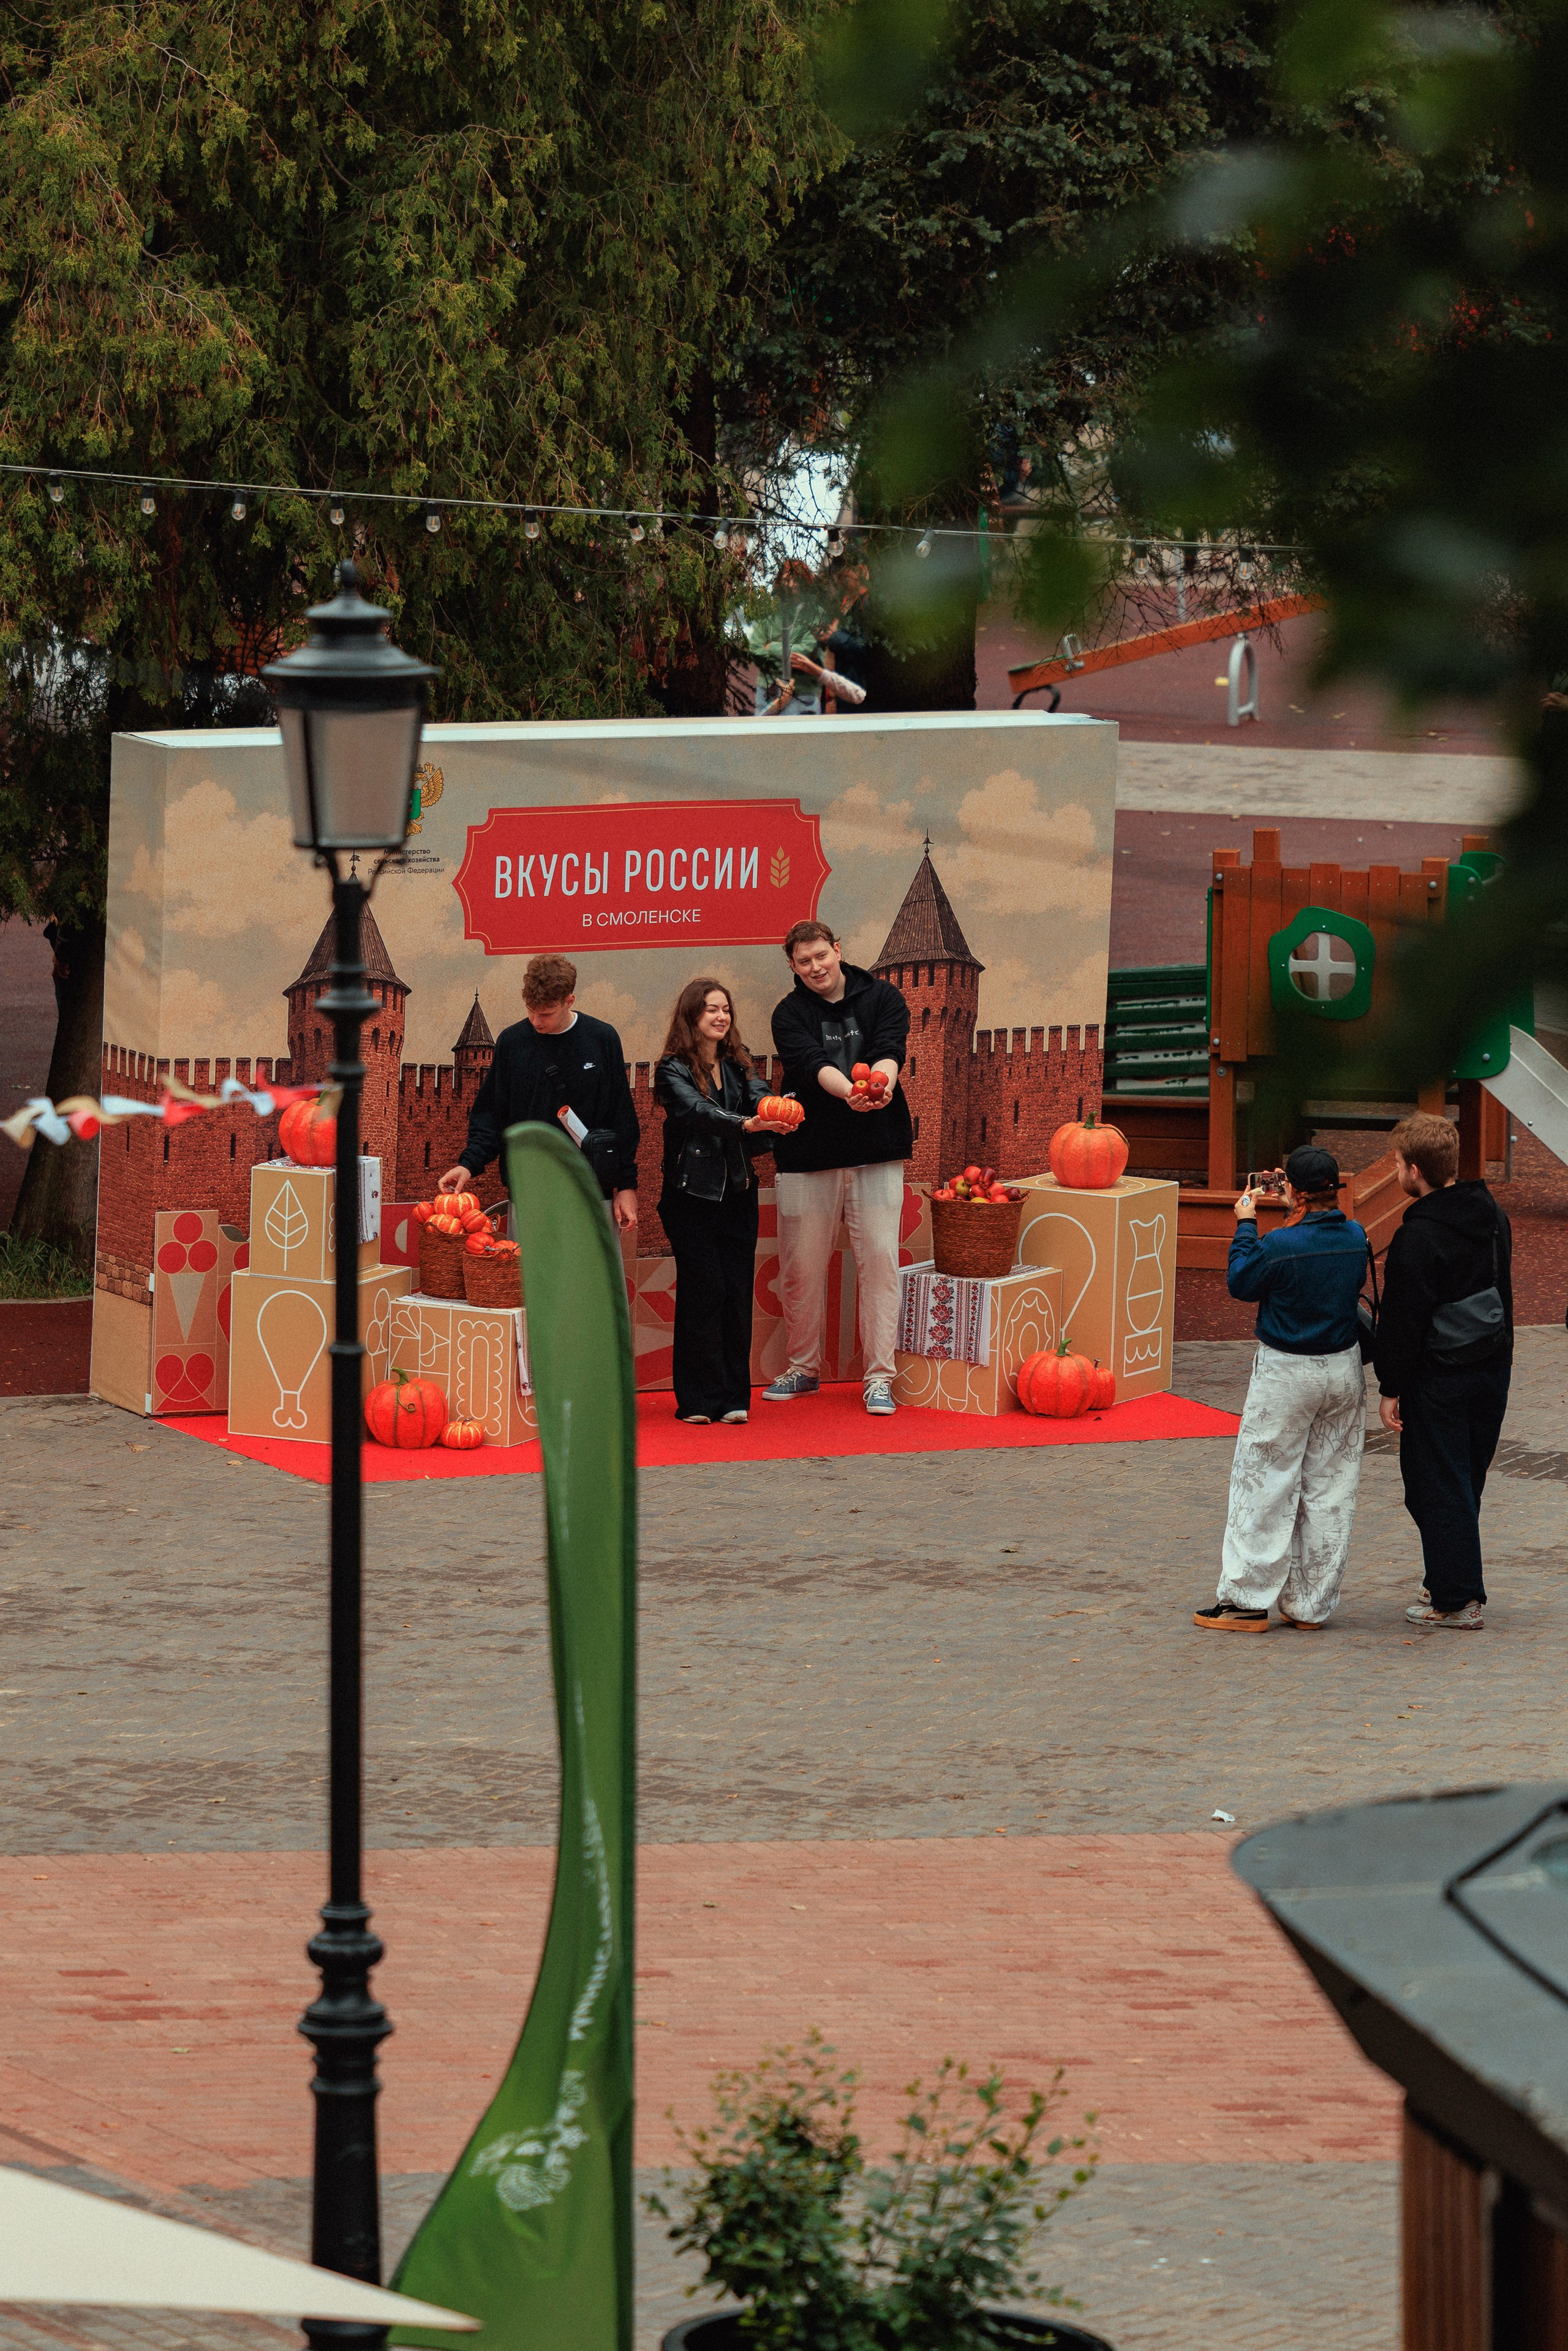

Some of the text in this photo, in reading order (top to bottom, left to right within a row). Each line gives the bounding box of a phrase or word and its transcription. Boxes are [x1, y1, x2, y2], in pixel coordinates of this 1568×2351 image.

[495, 847, 759, 899] ВКУСЫ РОССИИ
[582, 908, 701, 927] В СМОЛЕНСКЕ
